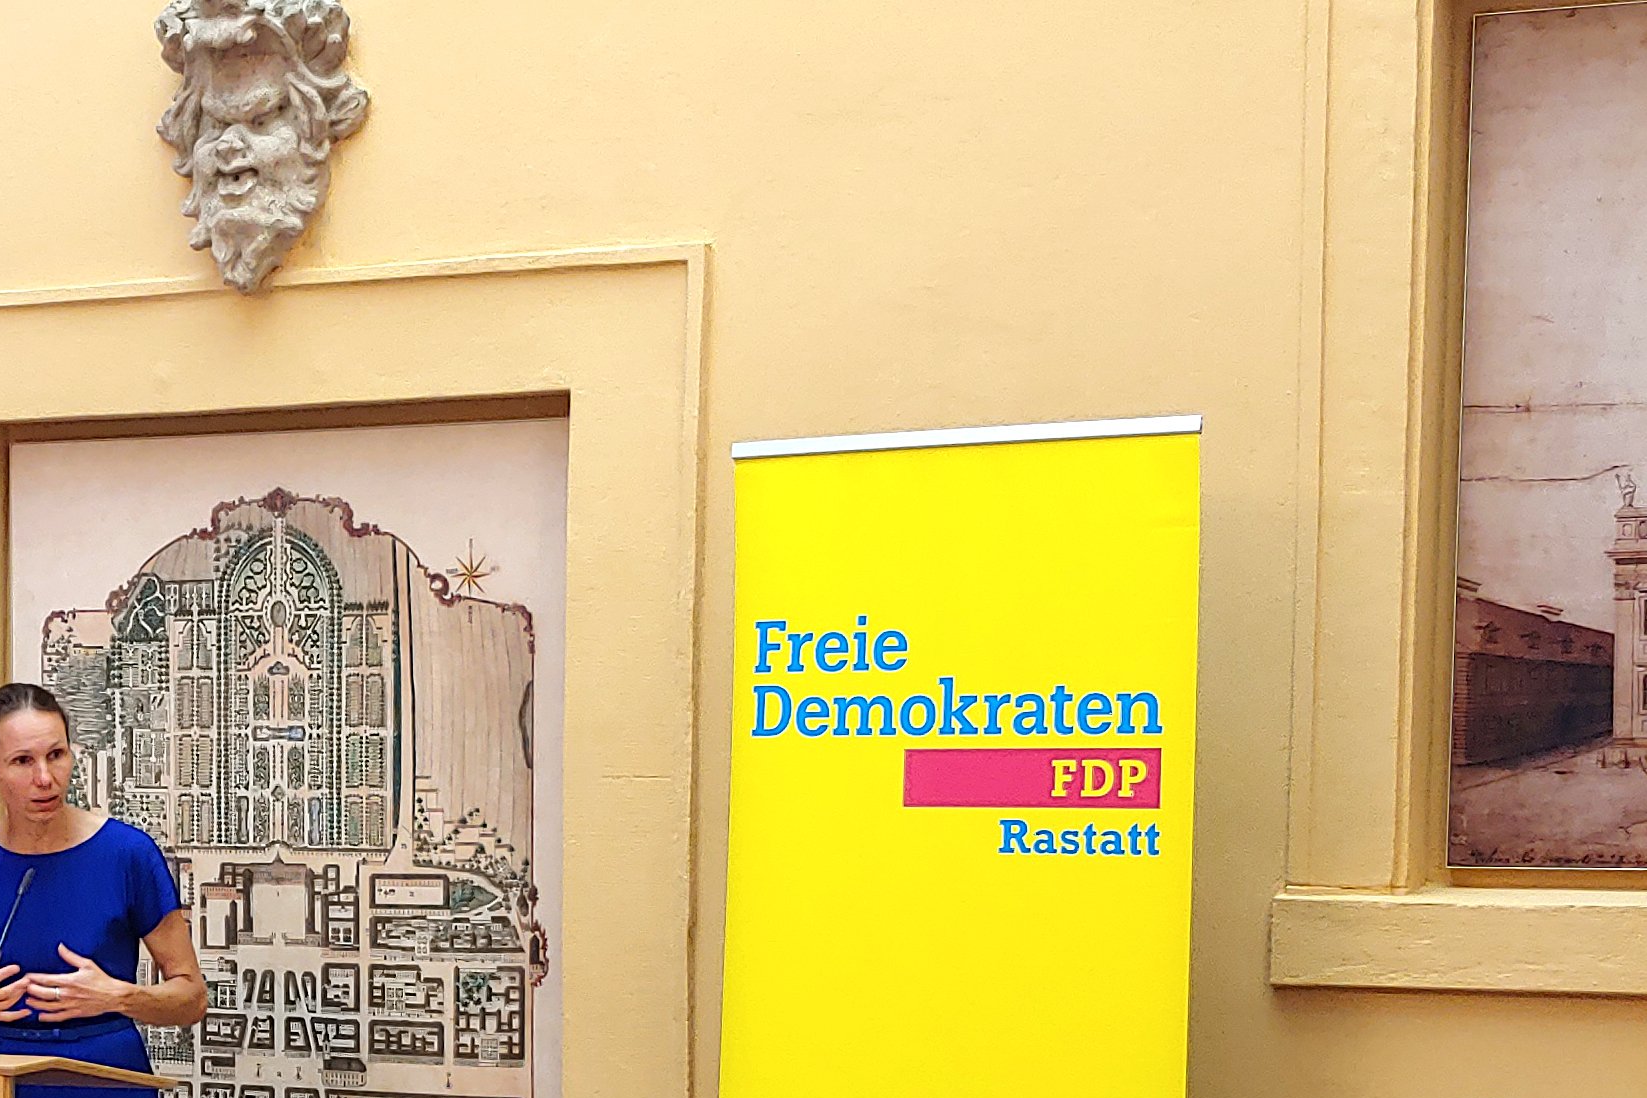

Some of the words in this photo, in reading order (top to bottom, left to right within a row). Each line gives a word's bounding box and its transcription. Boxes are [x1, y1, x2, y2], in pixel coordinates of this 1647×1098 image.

[754, 615, 908, 674] Freie
[751, 677, 1163, 737] Demokraten
[1051, 760, 1148, 798] FDP
[998, 820, 1161, 856] Rastatt
